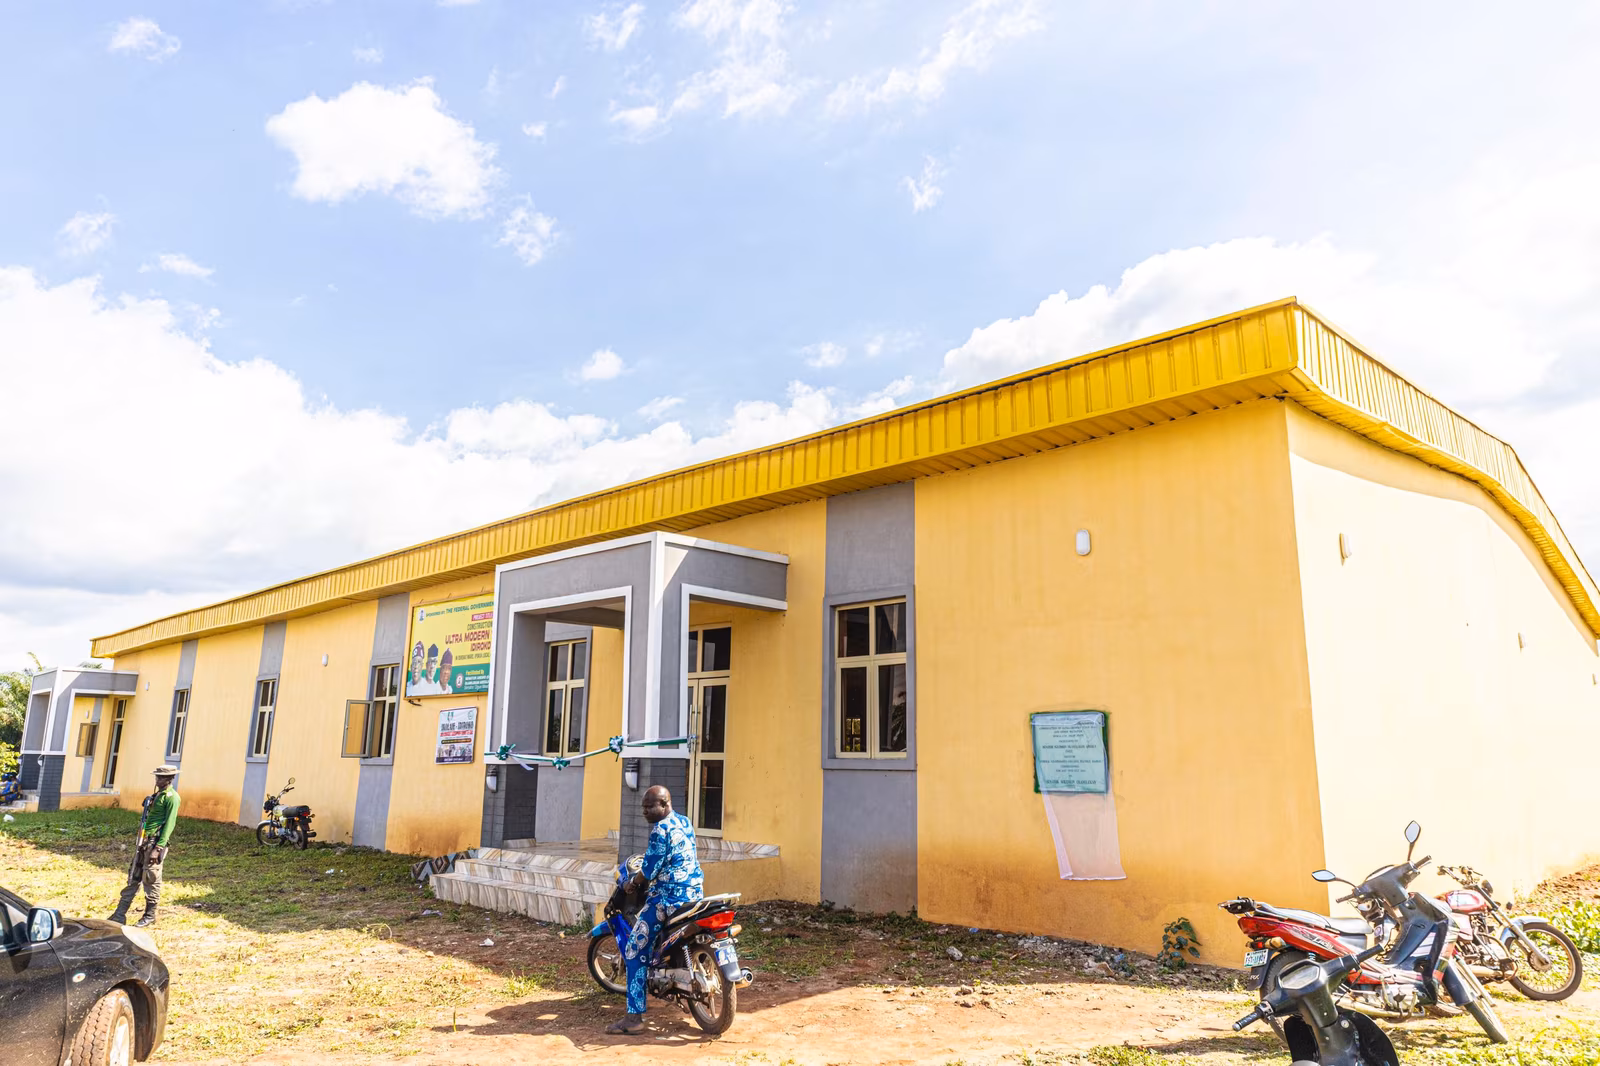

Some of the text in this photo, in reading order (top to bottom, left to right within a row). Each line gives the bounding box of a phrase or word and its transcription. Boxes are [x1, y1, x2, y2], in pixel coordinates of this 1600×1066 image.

[445, 630, 490, 644] ULTRA MODERN
[470, 641, 491, 652] IDIROKO
